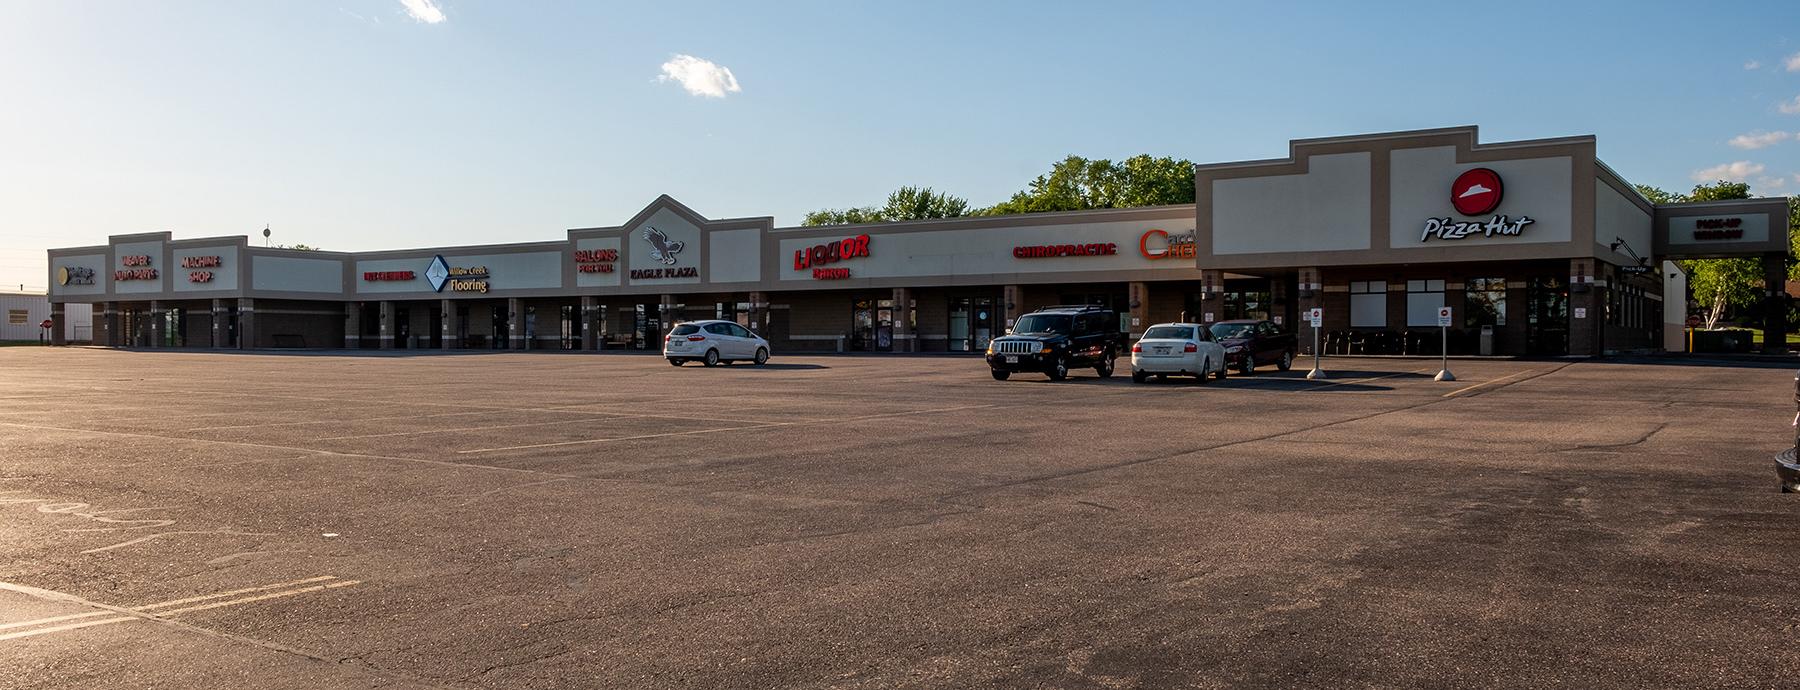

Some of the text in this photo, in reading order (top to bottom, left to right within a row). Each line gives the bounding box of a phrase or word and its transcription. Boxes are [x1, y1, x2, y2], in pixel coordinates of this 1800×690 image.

[1421, 214, 1535, 243] Pizza Hut
[574, 249, 618, 262] SALONS
[793, 234, 870, 271] LIQUOR
[1013, 243, 1117, 259] CHIROPRACTIC
[121, 255, 150, 266] WEAVER
[181, 256, 218, 268] MACHINE
[113, 268, 157, 281] AUTO PARTS
[449, 266, 486, 275] Willow Creek
[577, 263, 614, 273] FOR YOU
[630, 267, 699, 280] EAGLE PLAZA
[188, 271, 211, 283] SHOP
[451, 279, 488, 294] Flooring
